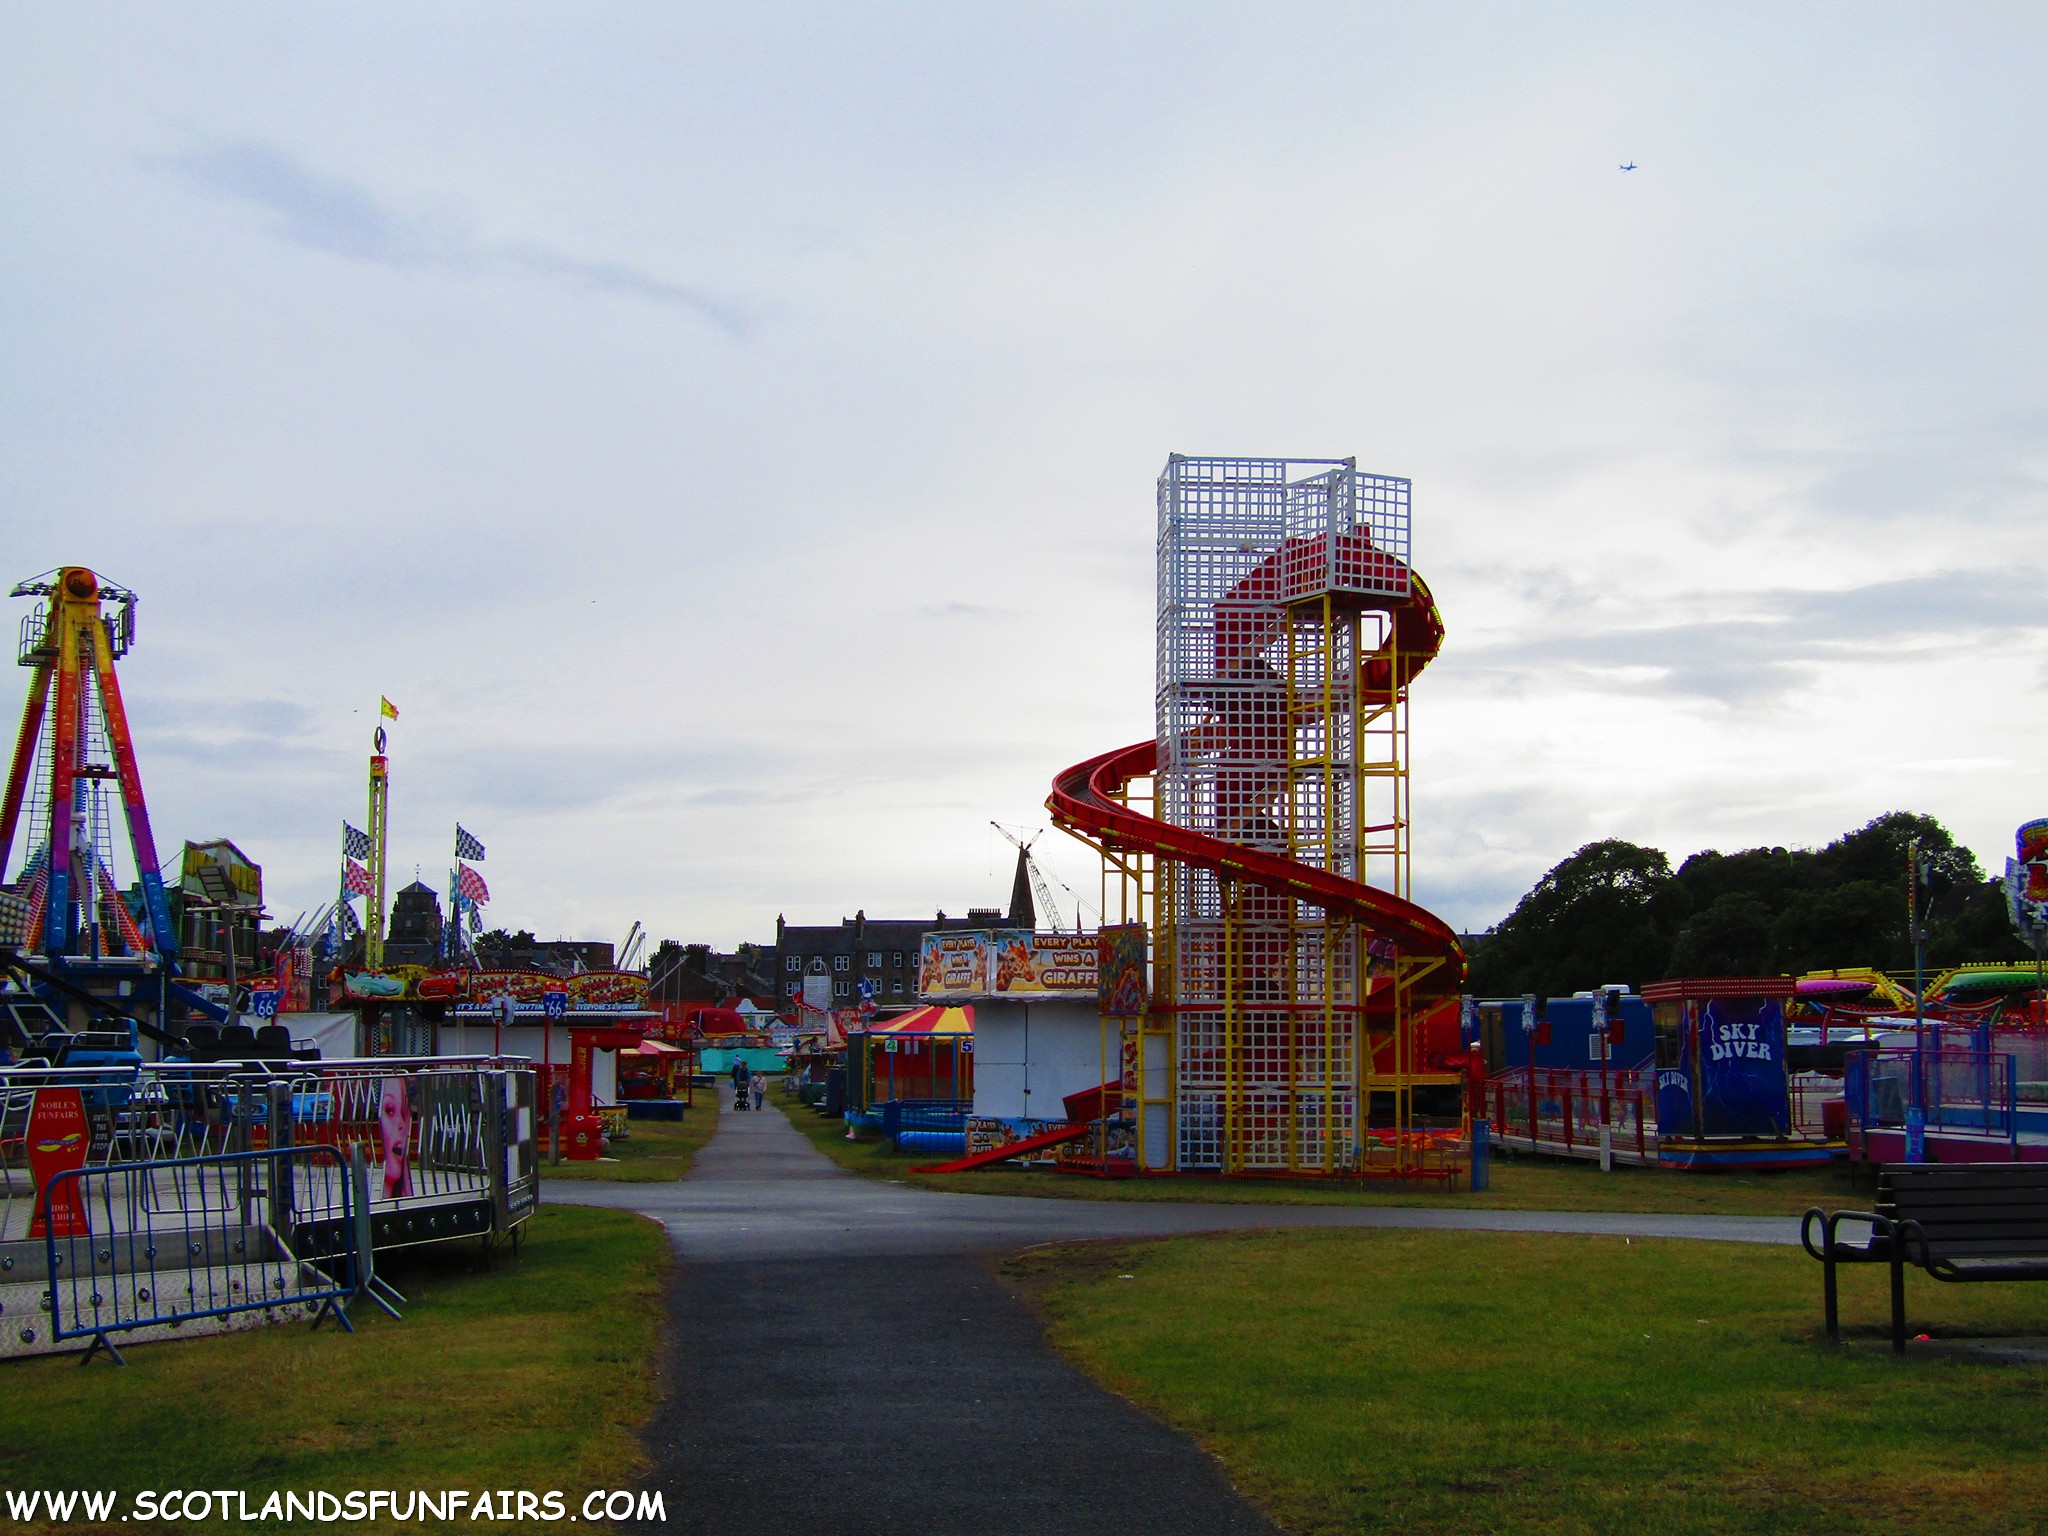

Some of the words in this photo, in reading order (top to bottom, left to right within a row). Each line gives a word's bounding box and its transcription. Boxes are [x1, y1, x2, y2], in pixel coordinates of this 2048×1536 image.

[1033, 937, 1067, 947] EVERY
[1073, 937, 1098, 947] PLAY
[1053, 954, 1080, 963] WINS
[1085, 954, 1093, 963] A
[945, 971, 971, 985] GIRAFFE
[258, 1000, 273, 1016] 66
[456, 1003, 473, 1011] IT'S
[548, 1001, 562, 1016] 66
[1719, 1023, 1760, 1041] SKY
[962, 1041, 973, 1051] 5
[1710, 1041, 1771, 1060] DIVER
[1658, 1072, 1670, 1090] SKY
[1670, 1071, 1689, 1092] DIVER
[40, 1101, 77, 1110] NOBLE'S
[37, 1111, 79, 1120] FUNFAIRS
[51, 1204, 70, 1212] IDES
